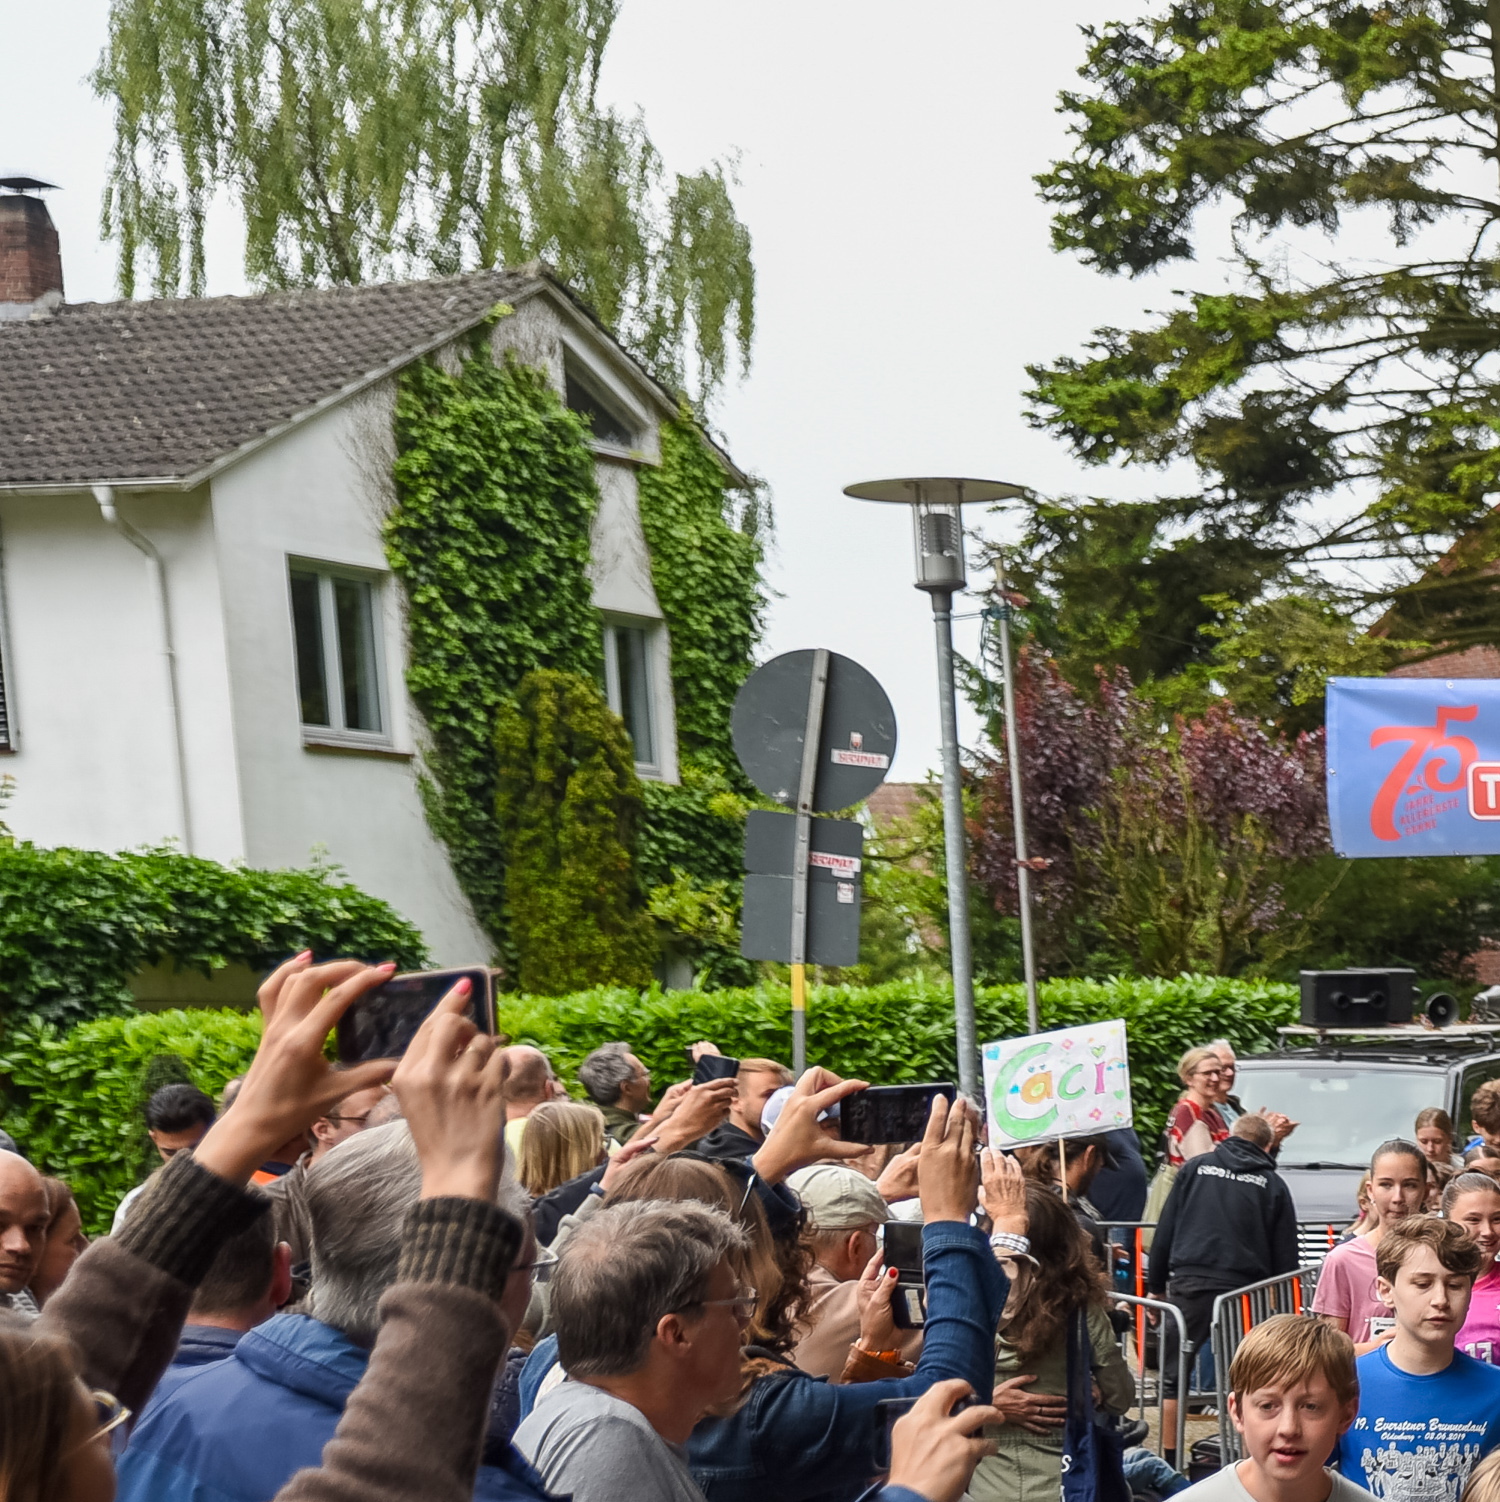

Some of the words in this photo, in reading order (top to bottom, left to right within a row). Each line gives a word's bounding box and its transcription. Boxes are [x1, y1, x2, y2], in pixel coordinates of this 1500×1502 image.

[1355, 1417, 1369, 1431] 19.
[1374, 1417, 1427, 1432] Everstener
[1428, 1417, 1488, 1436] Brunnenlauf
